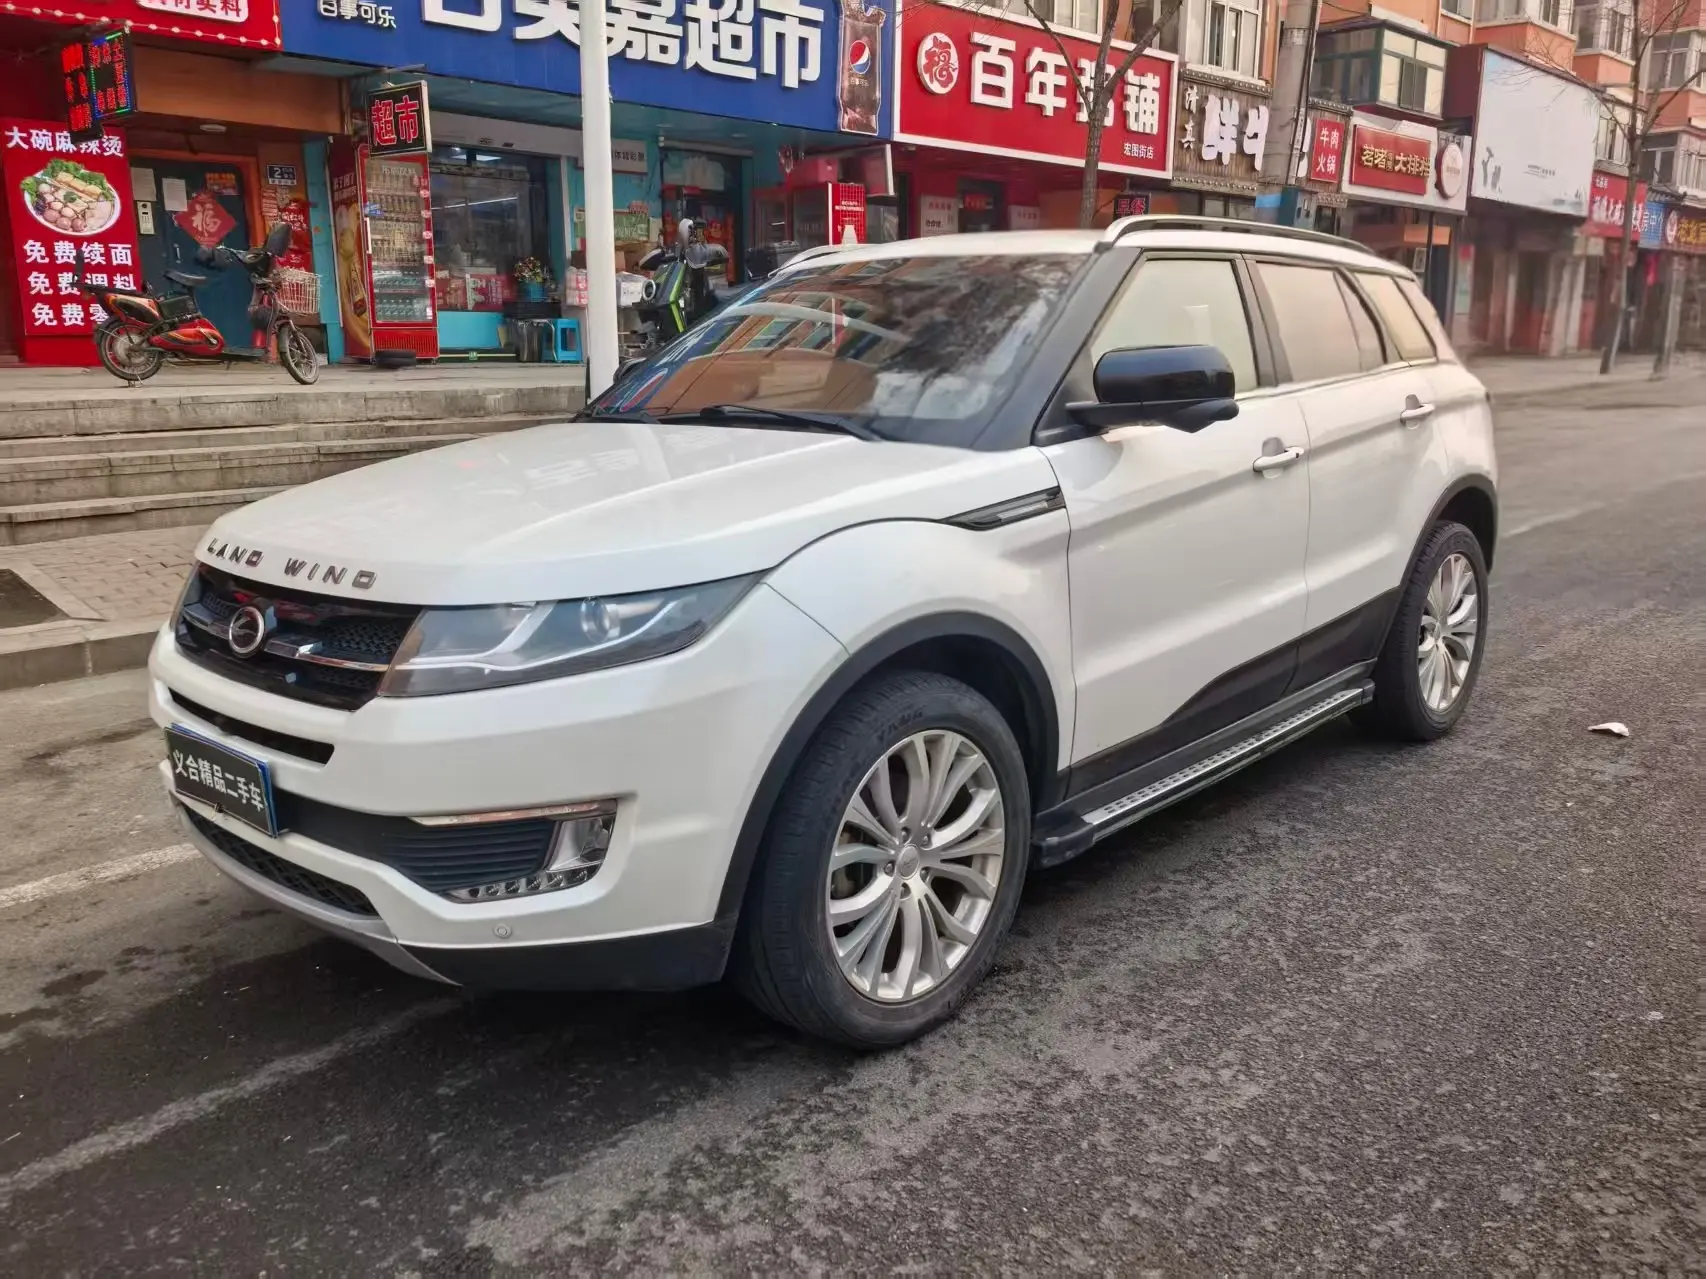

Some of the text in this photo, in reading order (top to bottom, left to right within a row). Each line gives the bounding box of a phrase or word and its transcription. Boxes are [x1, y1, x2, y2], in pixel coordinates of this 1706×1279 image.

[371, 95, 420, 146] 超市
[1320, 128, 1340, 150] 牛肉
[1124, 143, 1154, 160] 宏图街店
[1316, 153, 1337, 175] 火锅
[1117, 198, 1146, 216] 早餐
[23, 240, 133, 266] 免费续面
[207, 538, 377, 589] LAND WIND
